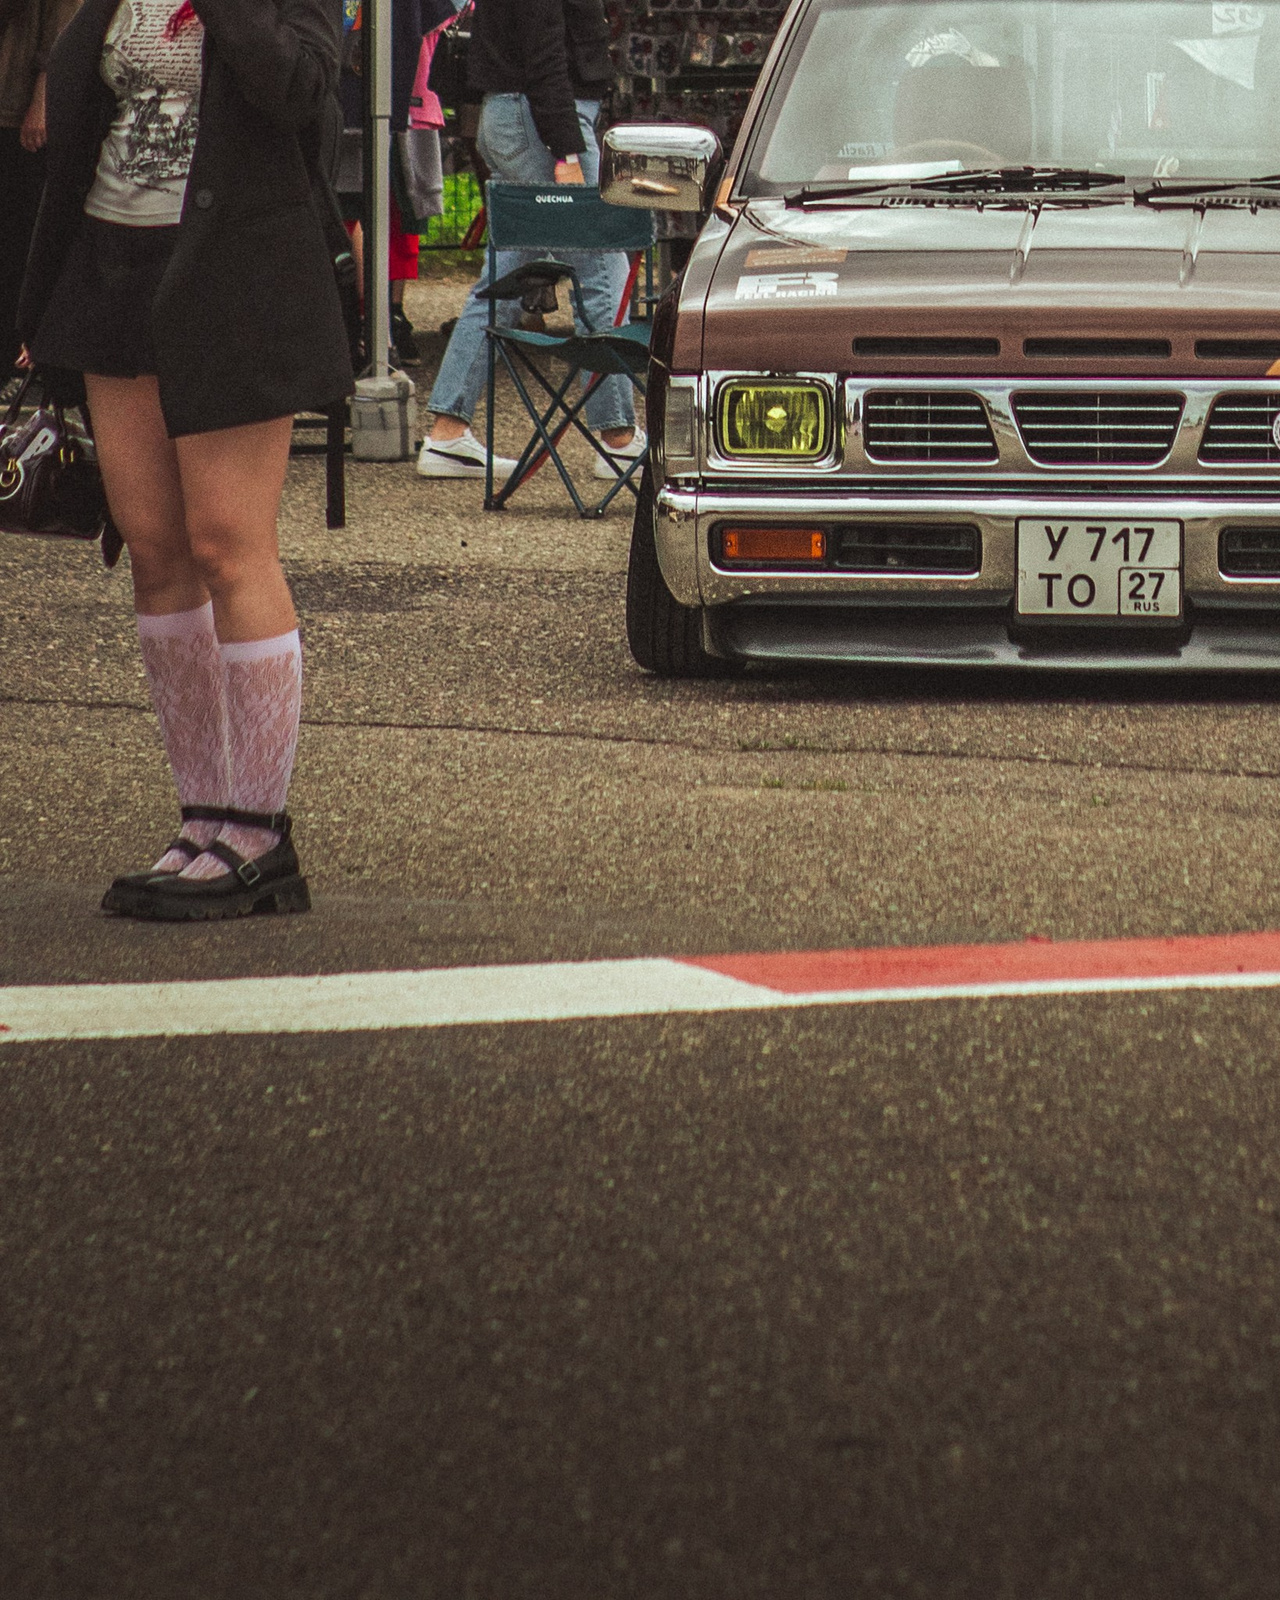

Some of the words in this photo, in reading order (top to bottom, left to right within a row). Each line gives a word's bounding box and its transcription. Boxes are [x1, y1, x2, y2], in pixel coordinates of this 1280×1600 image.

[535, 194, 574, 204] QUECHUA
[1086, 526, 1155, 562] 717
[1128, 572, 1165, 600] 27
[1134, 602, 1160, 612] RUS
